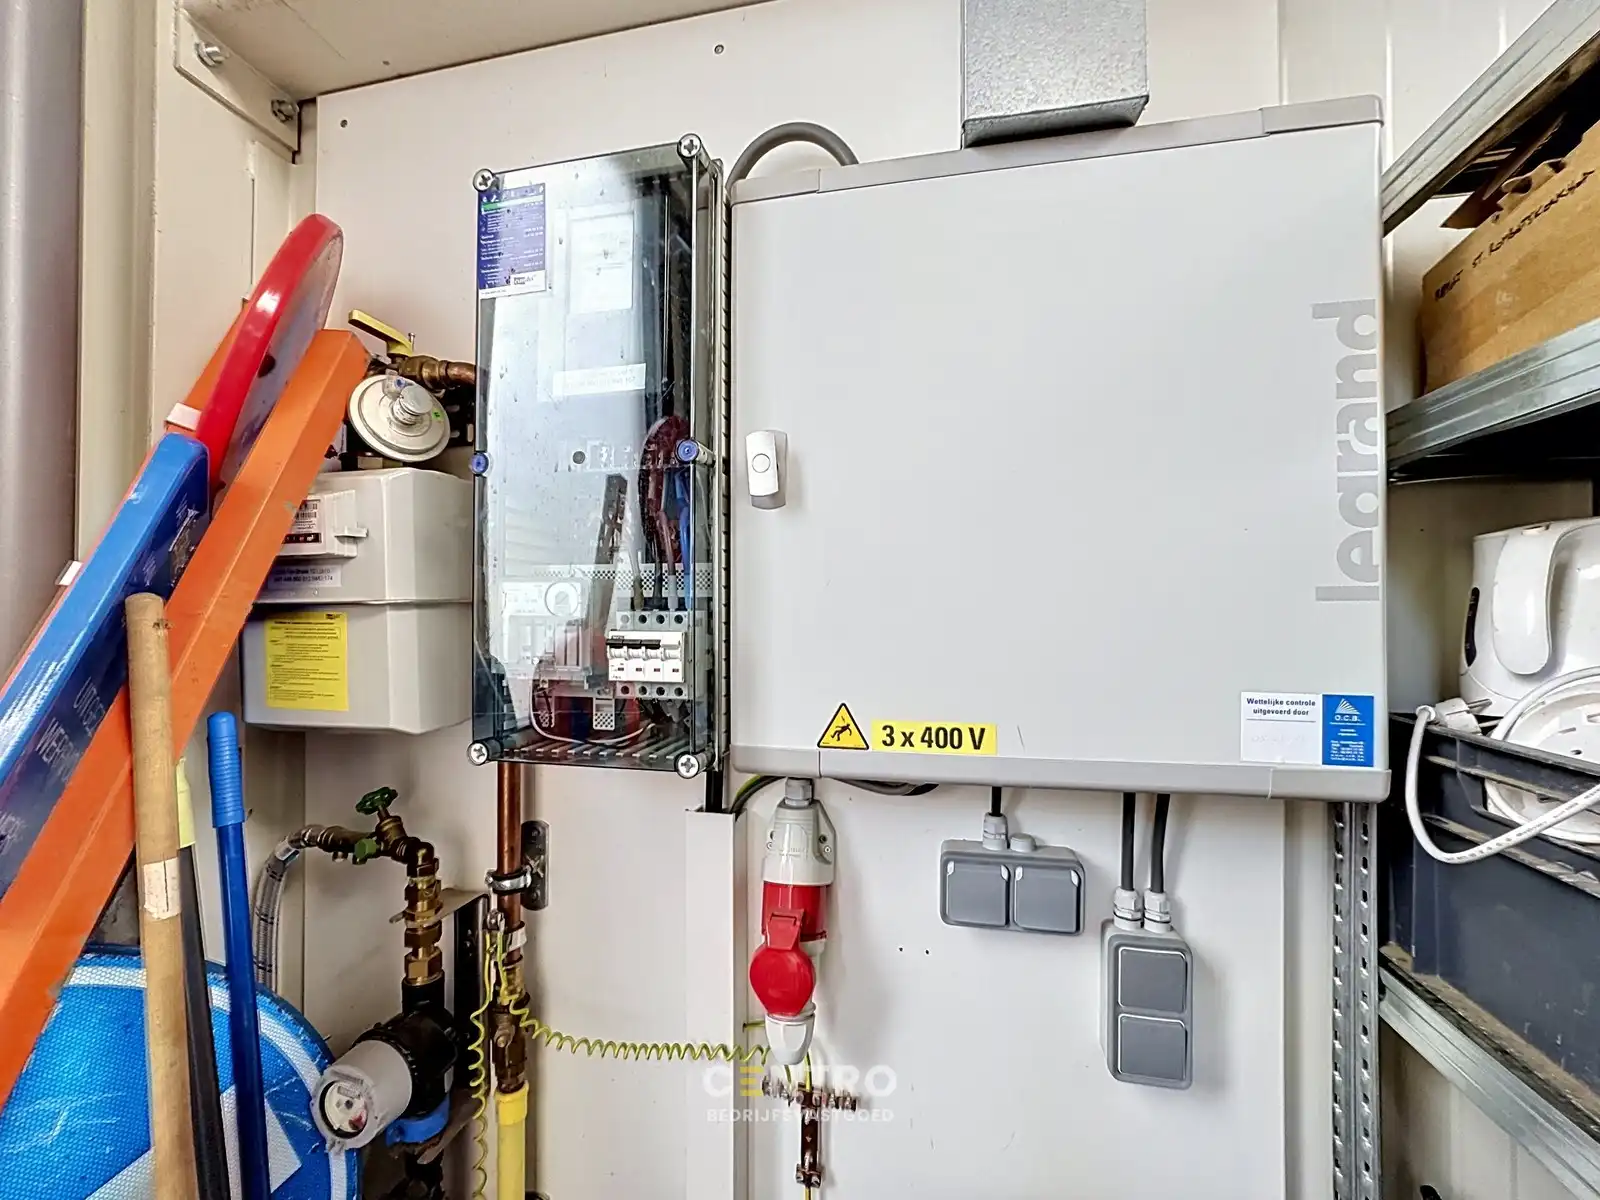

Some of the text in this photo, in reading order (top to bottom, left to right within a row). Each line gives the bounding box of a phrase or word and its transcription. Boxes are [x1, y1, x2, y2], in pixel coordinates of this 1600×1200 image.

[1311, 298, 1380, 602] legrand
[1246, 698, 1316, 707] Wettelijke controle
[1252, 708, 1309, 716] uitgevoerd door
[881, 724, 986, 750] 3 x 400 V
